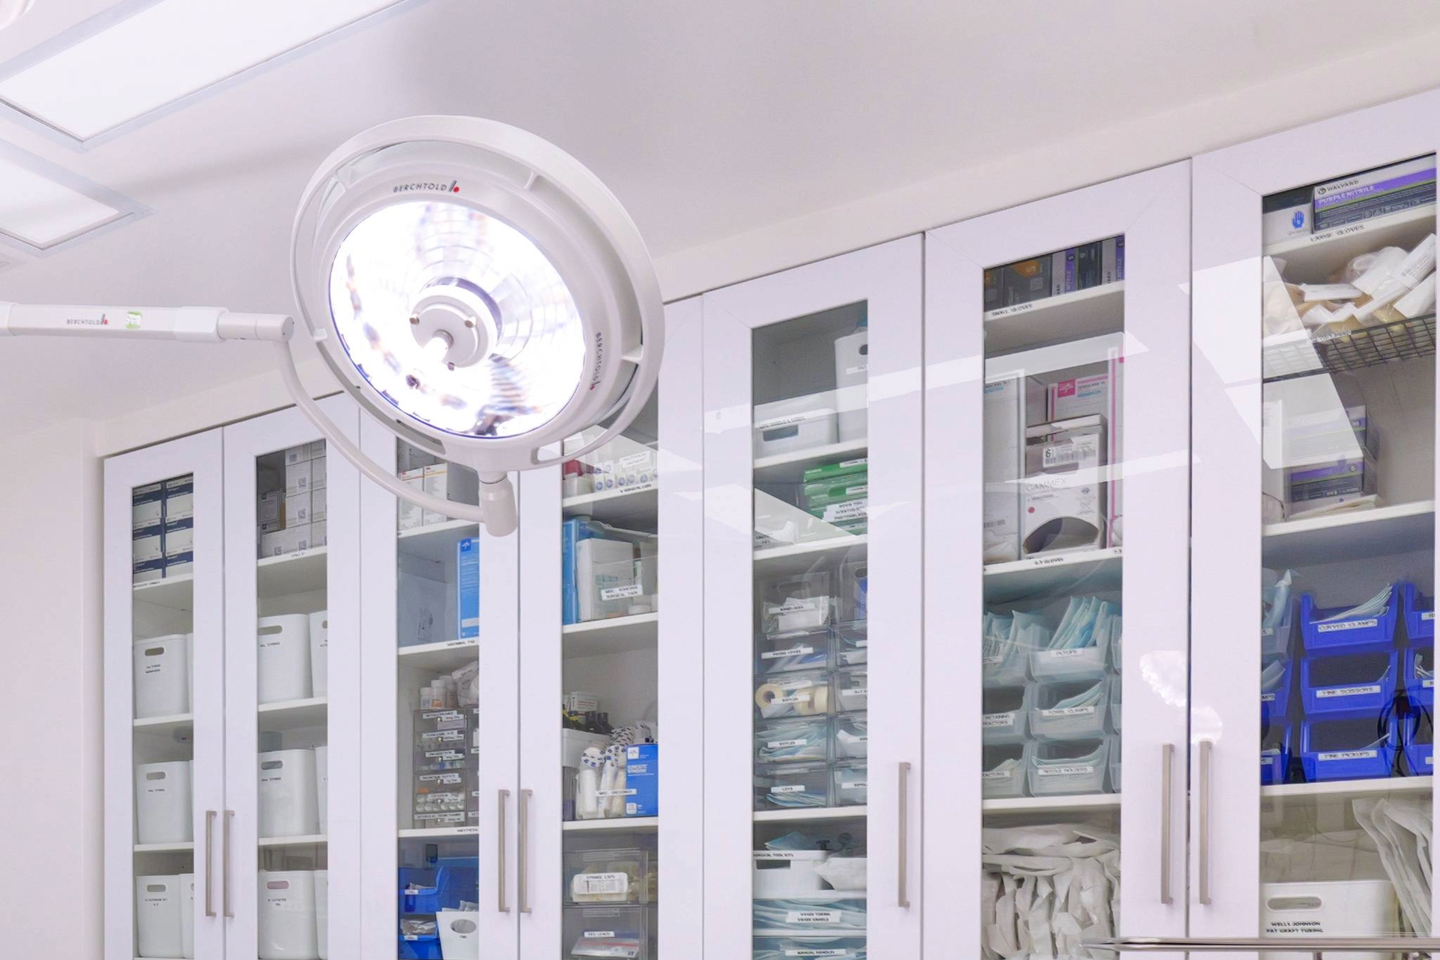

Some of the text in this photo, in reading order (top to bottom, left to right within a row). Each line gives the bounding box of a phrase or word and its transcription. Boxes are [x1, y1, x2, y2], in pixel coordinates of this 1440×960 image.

[392, 182, 448, 193] BERCHTOLD
[1336, 224, 1365, 236] GLOVES
[1025, 478, 1067, 493] GAMMEX
[1318, 619, 1377, 632] CURVED CLAMPS
[1340, 686, 1375, 696] SCISSORS
[1340, 750, 1371, 759] PICKUPS
